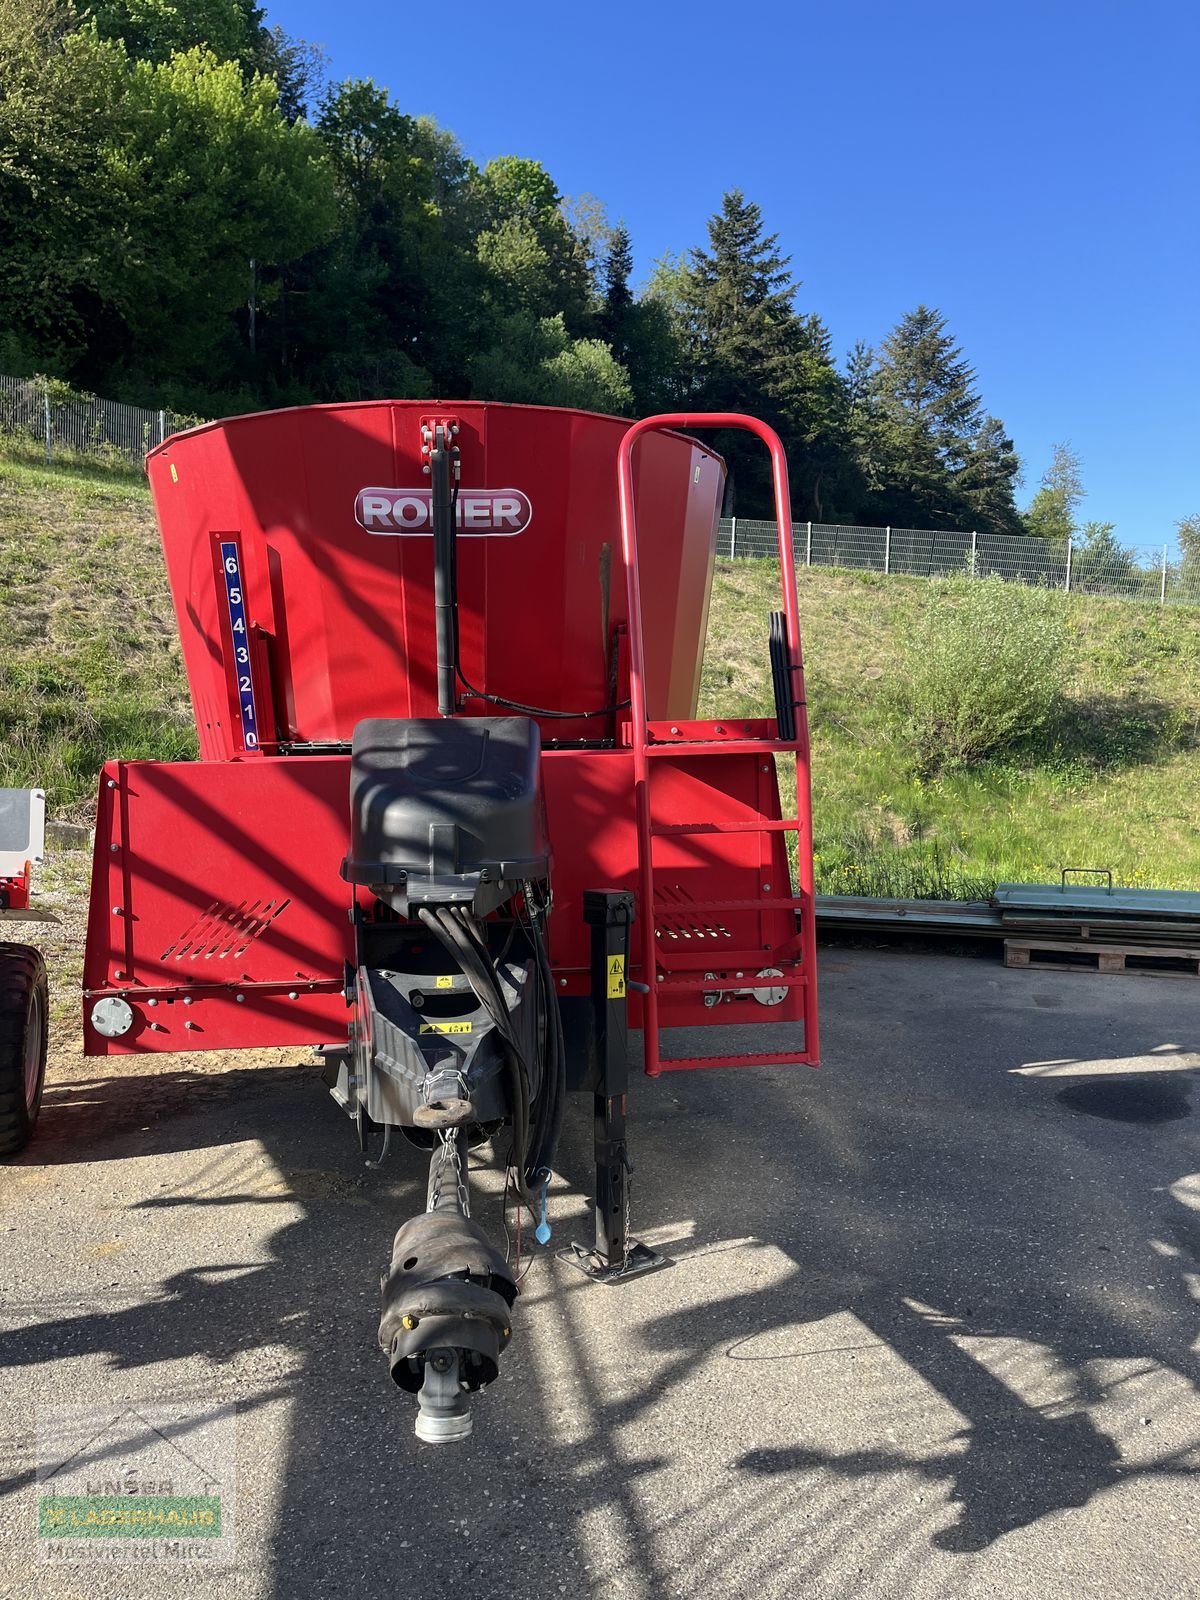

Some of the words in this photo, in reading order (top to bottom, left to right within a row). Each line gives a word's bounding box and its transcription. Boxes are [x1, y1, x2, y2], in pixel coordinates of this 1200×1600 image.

[225, 557, 238, 574] 6
[230, 587, 242, 604] 5
[233, 617, 245, 634] 4
[236, 647, 249, 663] 3
[239, 676, 252, 692] 2
[244, 704, 253, 720] 1
[245, 732, 257, 747] 0
